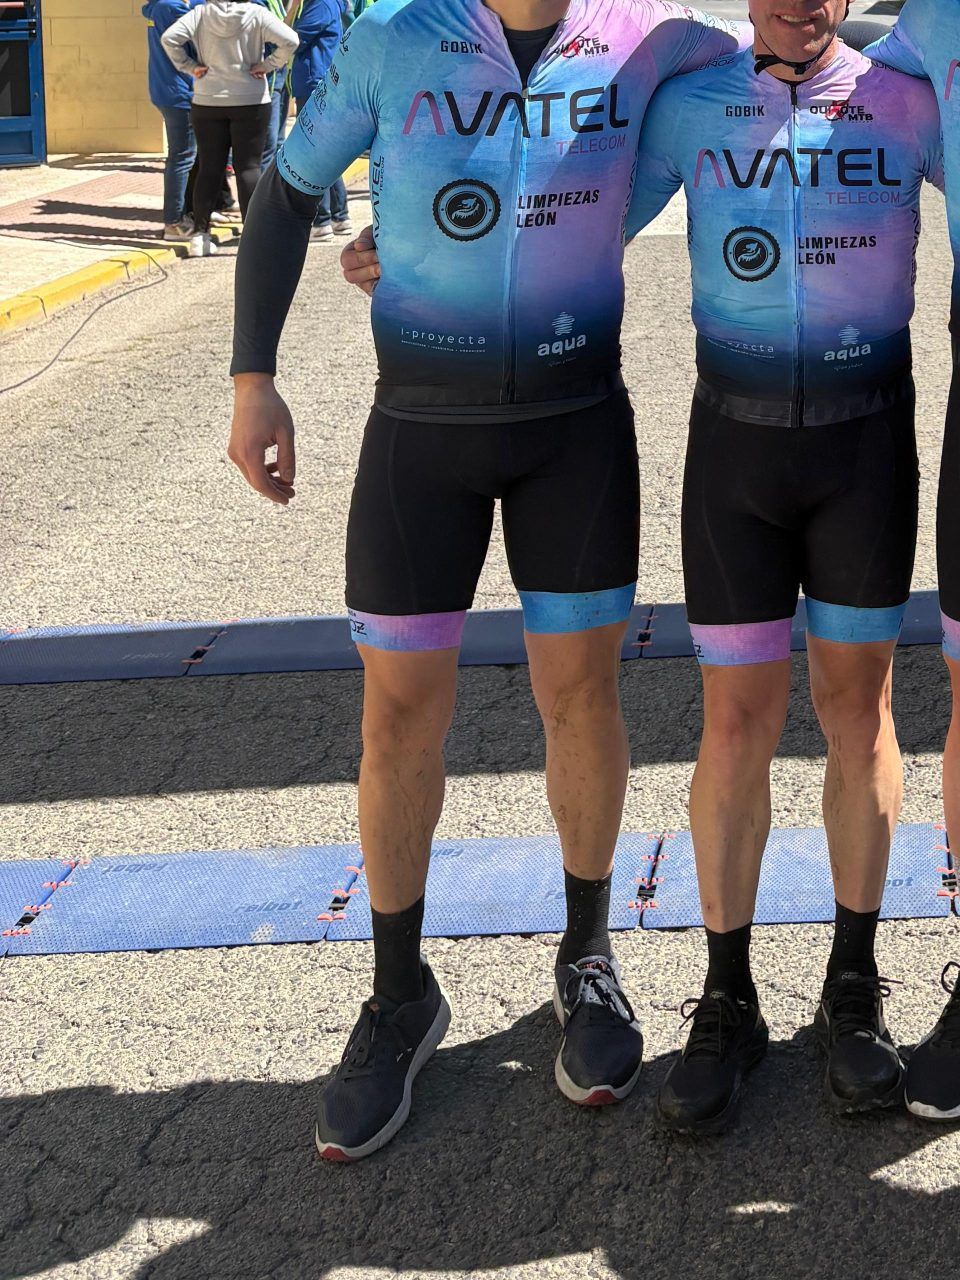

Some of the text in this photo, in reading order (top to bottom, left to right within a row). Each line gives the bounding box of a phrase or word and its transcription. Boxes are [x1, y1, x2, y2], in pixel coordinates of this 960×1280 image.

[440, 40, 485, 54] GOBIK
[584, 44, 609, 56] MTB
[403, 83, 630, 139] AVATEL
[725, 105, 765, 117] GOBIK
[556, 134, 626, 156] TELECOM
[693, 147, 901, 189] AVATEL
[517, 189, 600, 210] LIMPIEZAS
[827, 192, 900, 205] TELECOM
[516, 210, 557, 229] LEÓN
[798, 235, 877, 250] LIMPIEZAS
[798, 250, 836, 265] LEÓN
[537, 334, 587, 356] aqua
[824, 344, 871, 360] aqua
